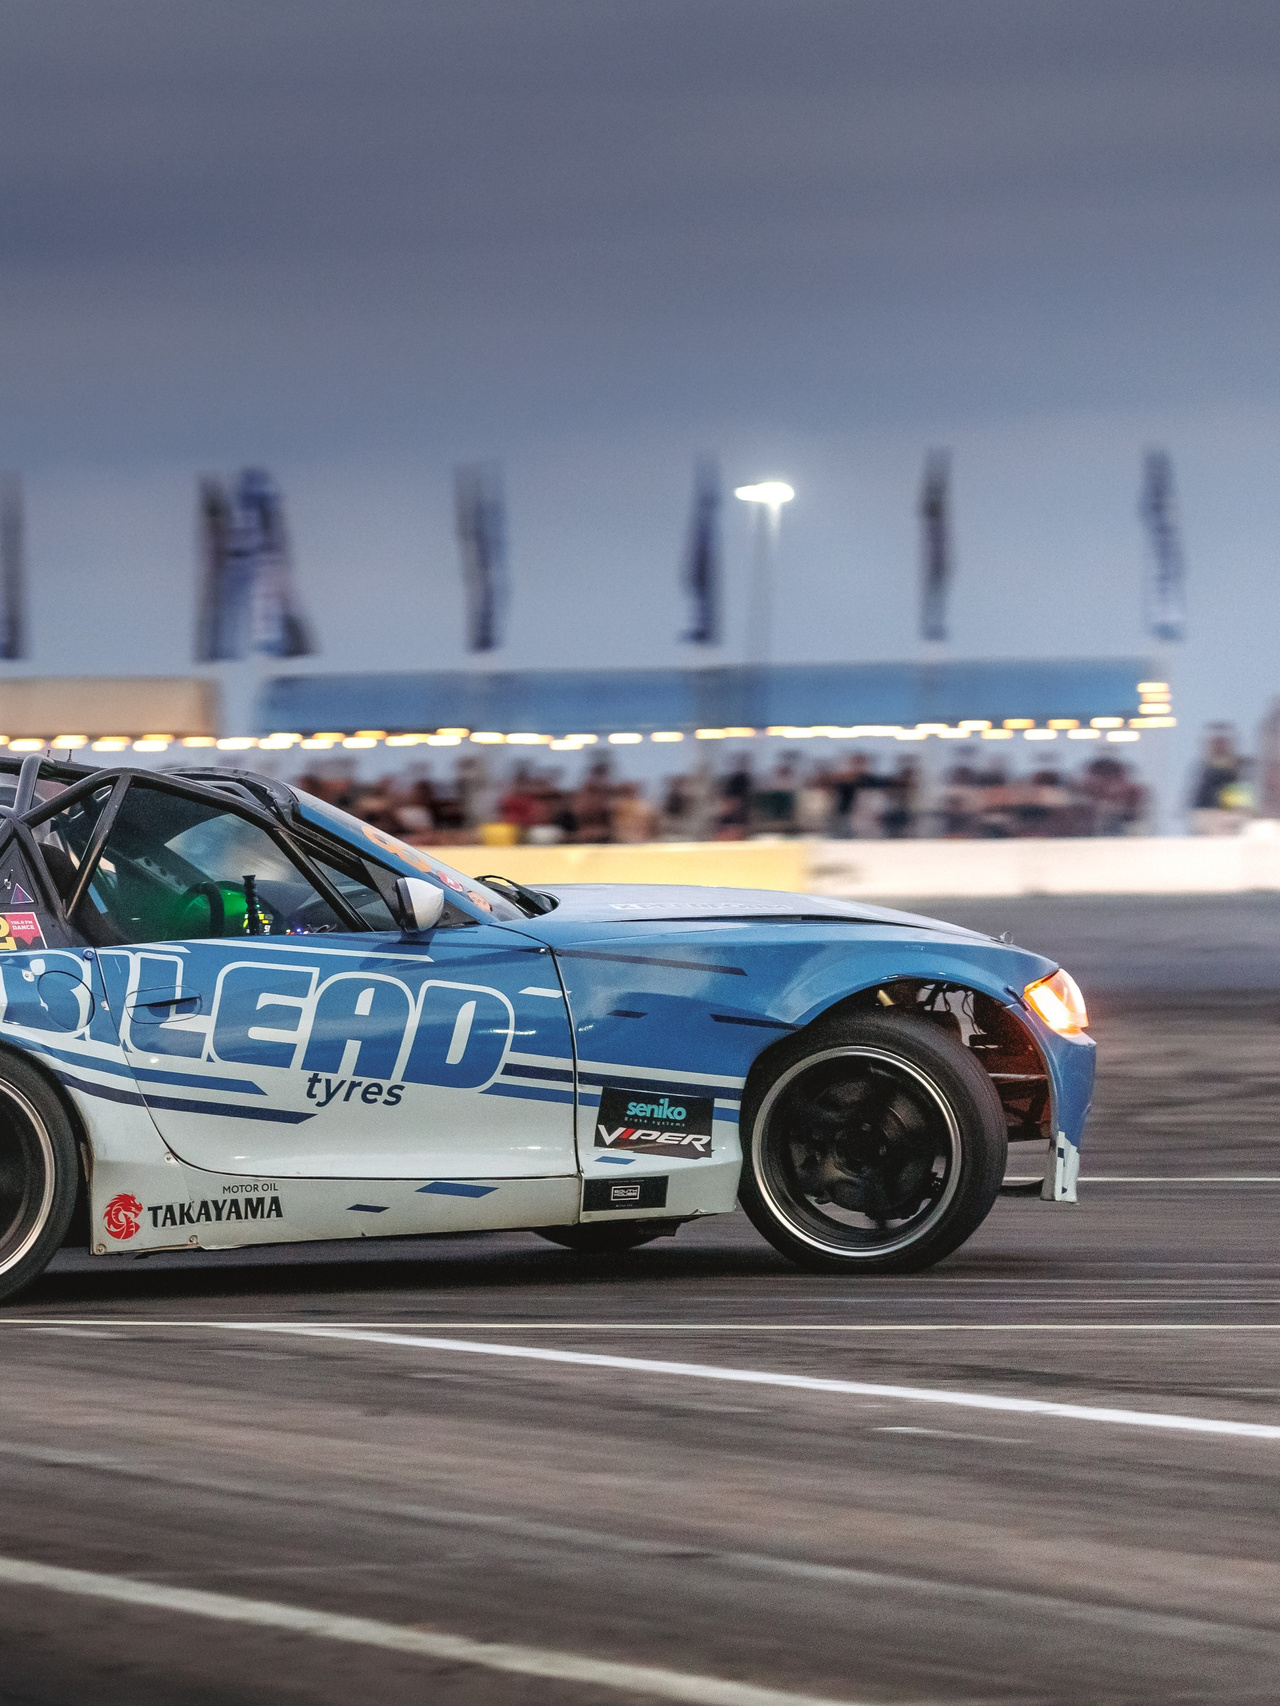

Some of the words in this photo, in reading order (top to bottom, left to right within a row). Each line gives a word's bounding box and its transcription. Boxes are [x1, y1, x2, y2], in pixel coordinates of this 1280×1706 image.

[305, 1072, 405, 1107] tyres
[626, 1098, 687, 1120] seniko
[597, 1124, 711, 1152] VIPER
[222, 1184, 259, 1194] MOTOR
[261, 1183, 279, 1192] OIL
[147, 1196, 283, 1228] TAKAYAMA
